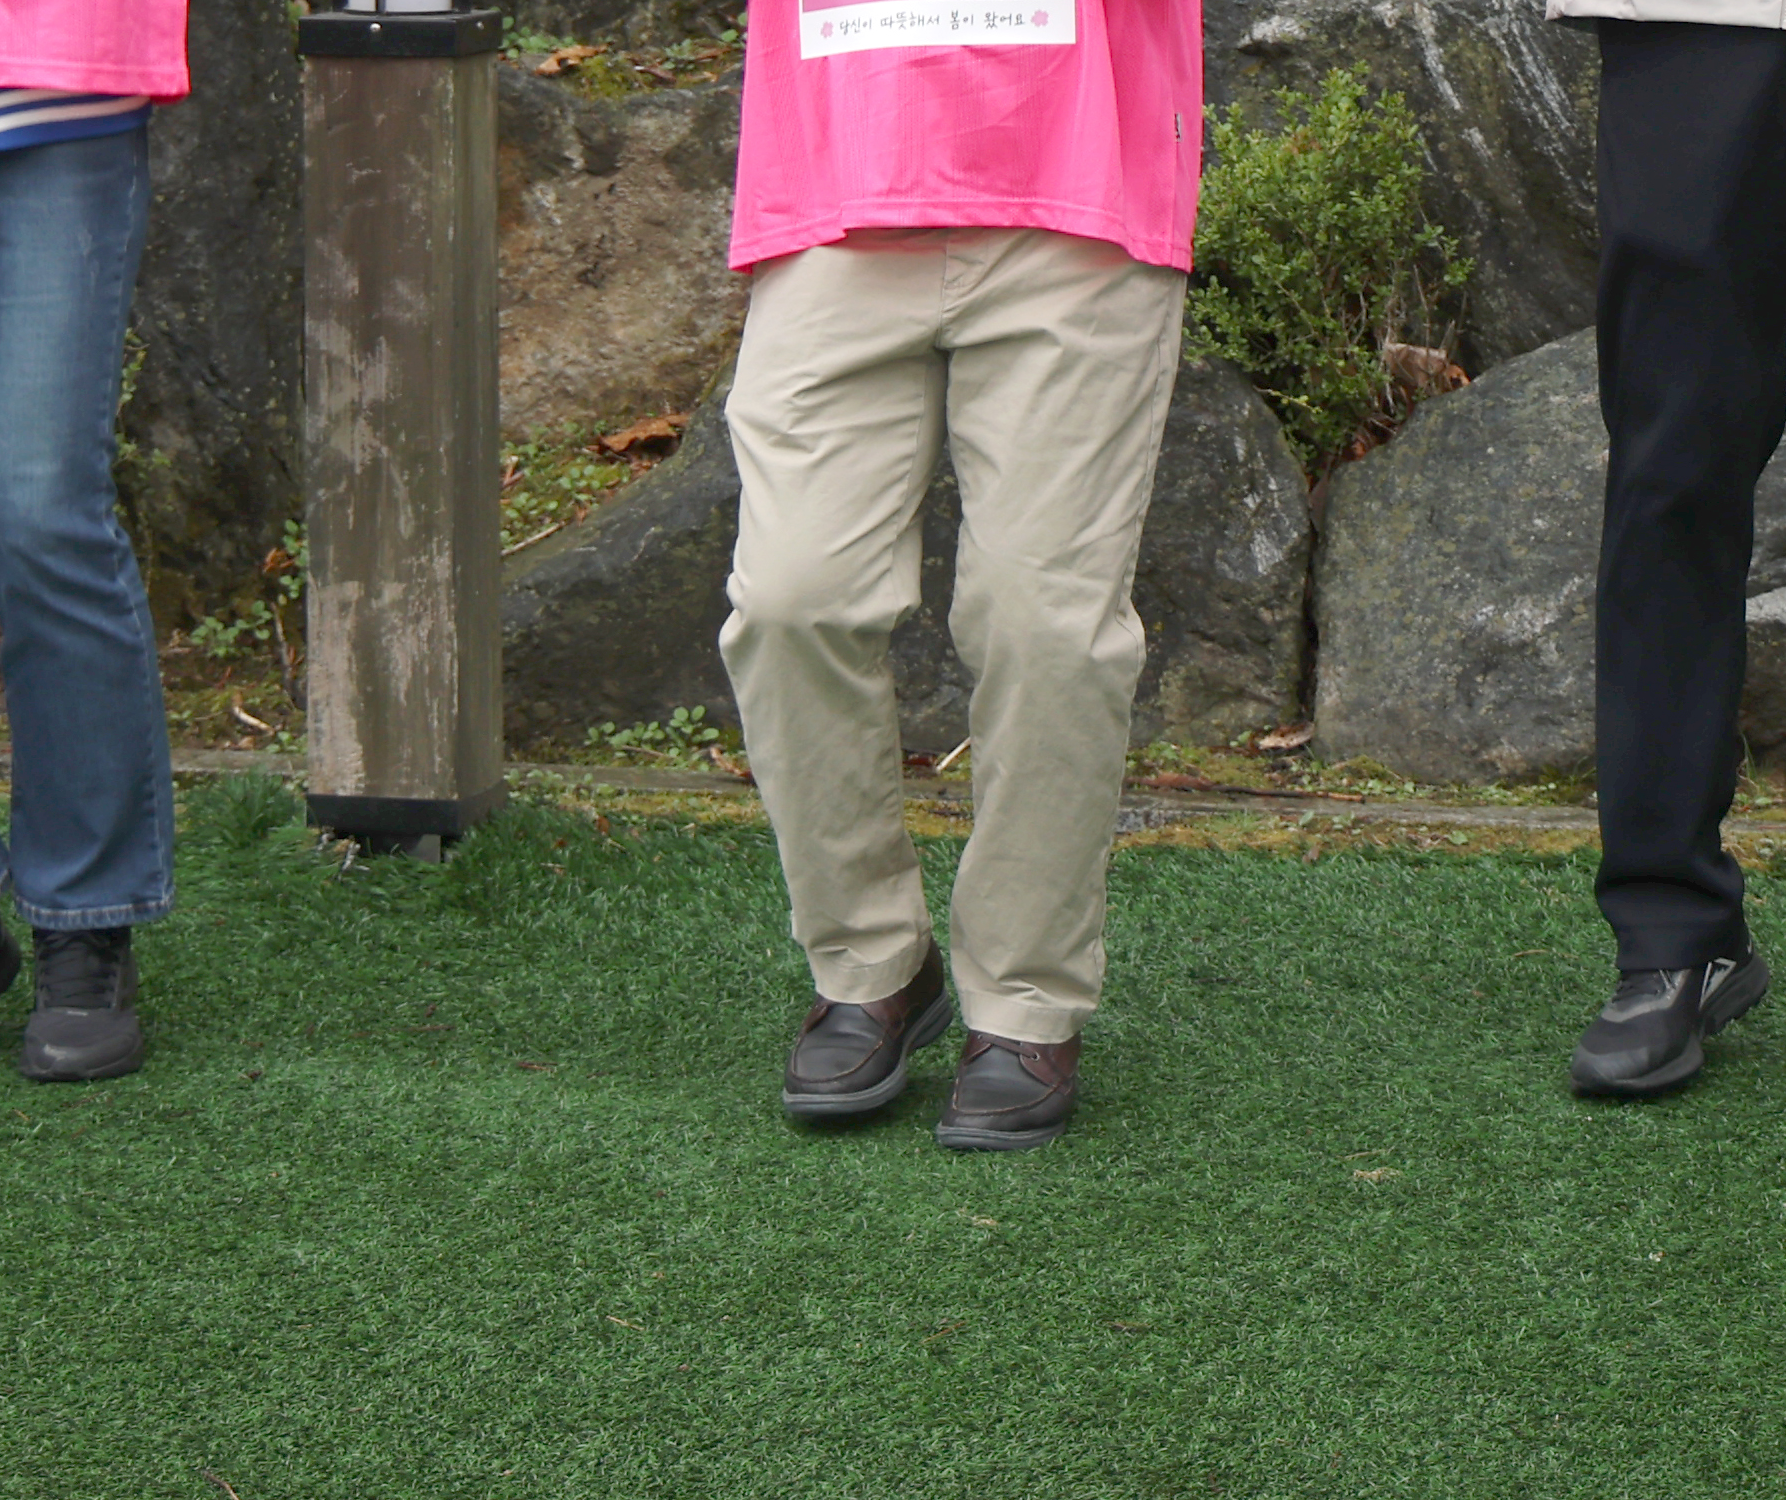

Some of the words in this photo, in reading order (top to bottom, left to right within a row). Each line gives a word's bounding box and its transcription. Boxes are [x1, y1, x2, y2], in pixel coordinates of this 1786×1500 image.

[839, 19, 872, 34] 당신이
[881, 12, 940, 29] 따뜻해서
[950, 10, 974, 29] 봄이
[984, 11, 1025, 28] 왔어요
